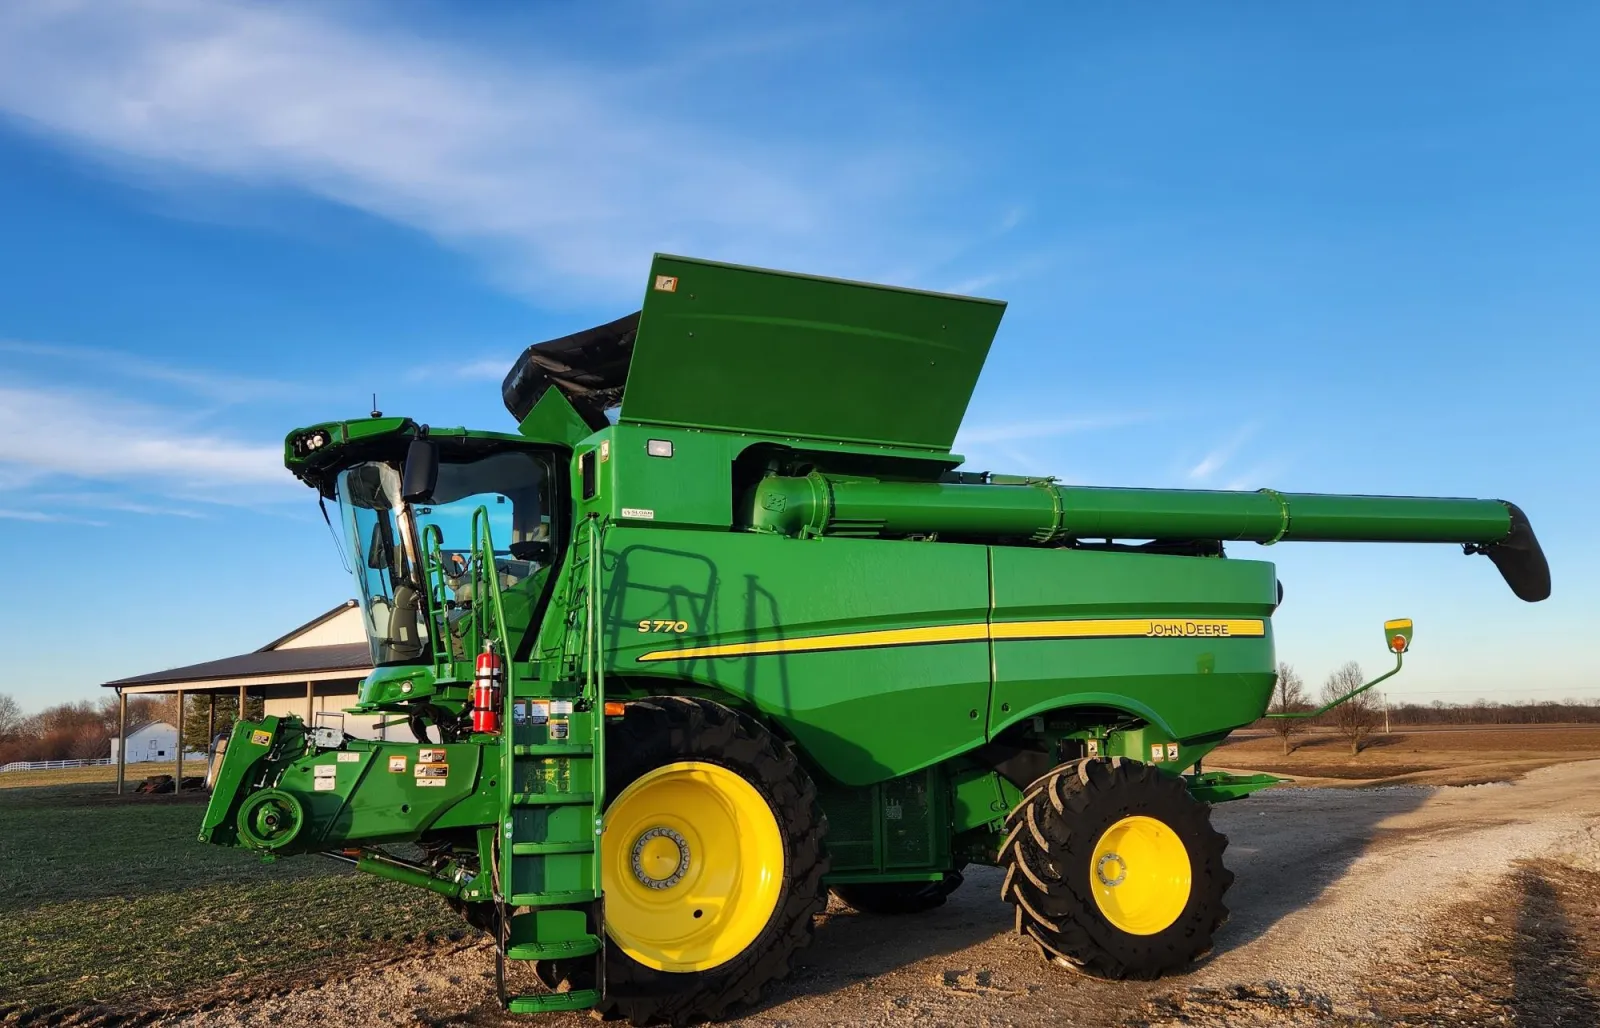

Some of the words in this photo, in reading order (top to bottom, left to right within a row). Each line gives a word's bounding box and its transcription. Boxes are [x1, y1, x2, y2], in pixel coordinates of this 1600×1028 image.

[638, 620, 688, 633] S770
[1146, 622, 1183, 635] JOHN
[1186, 622, 1229, 635] DEERE
